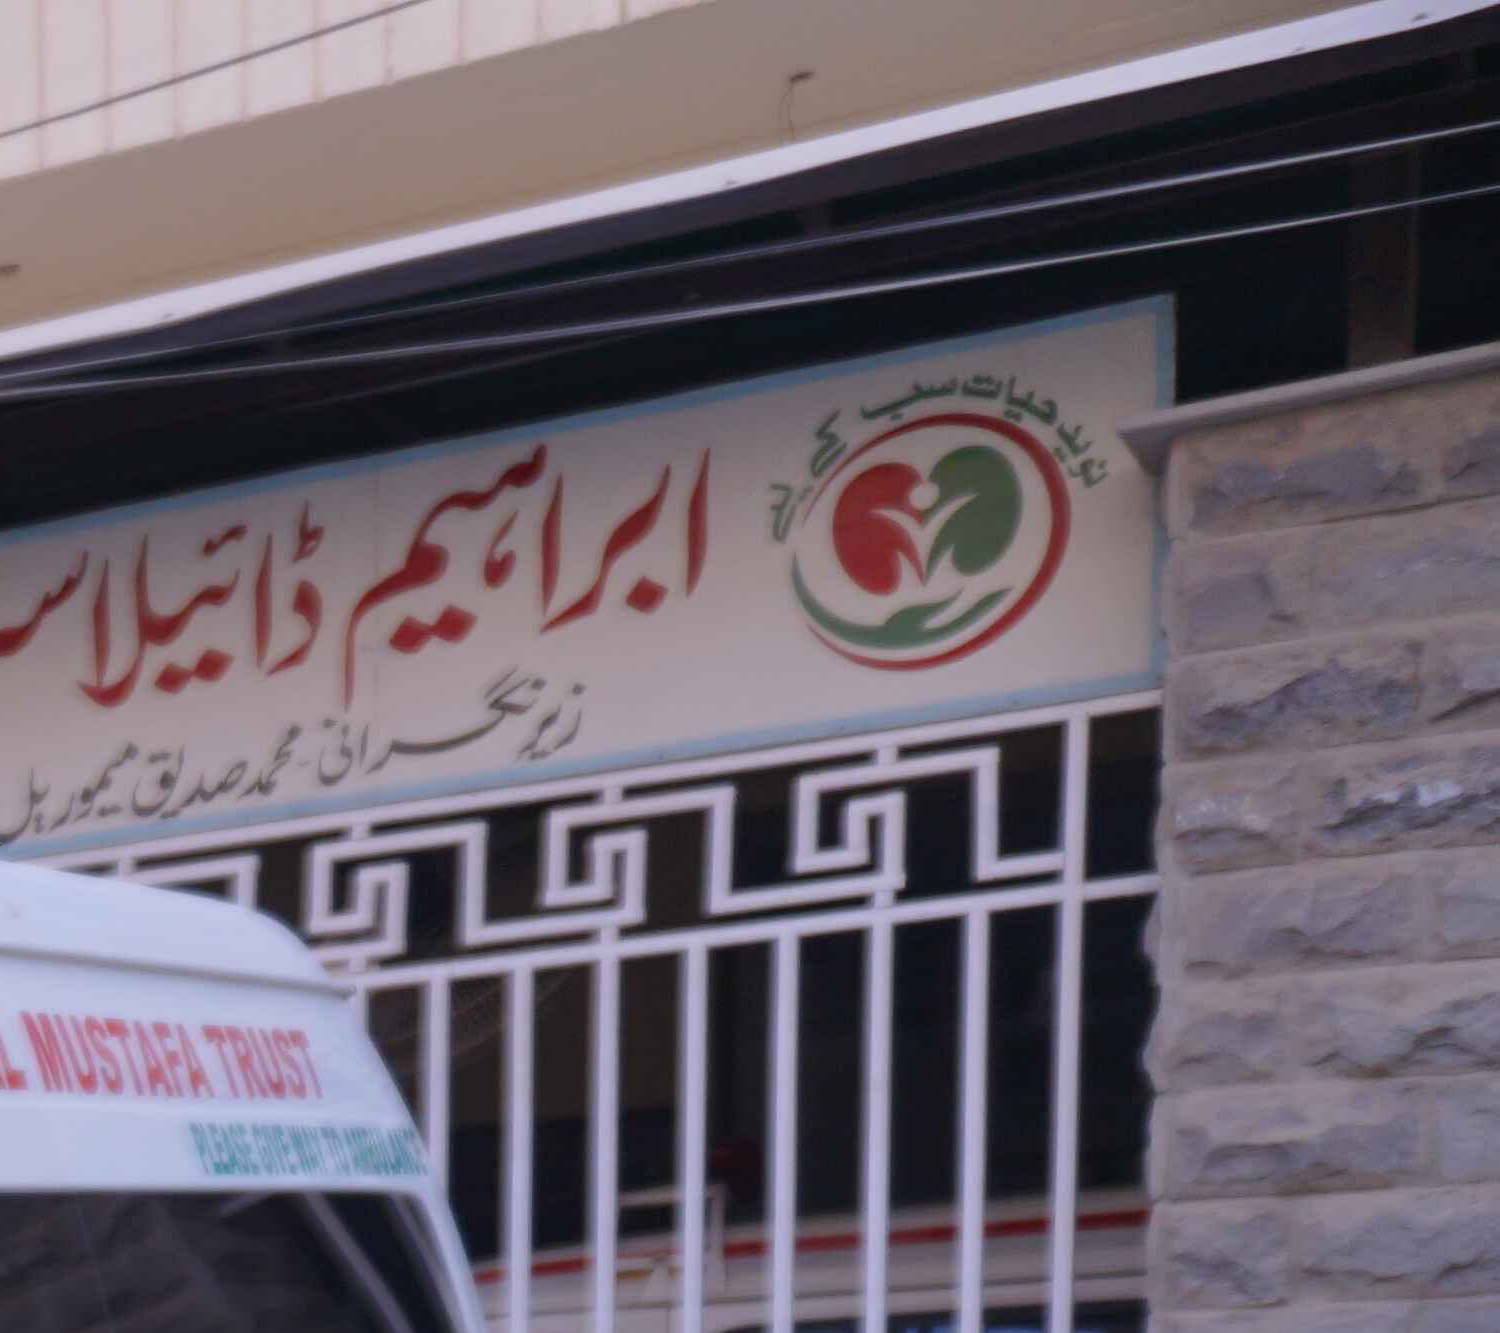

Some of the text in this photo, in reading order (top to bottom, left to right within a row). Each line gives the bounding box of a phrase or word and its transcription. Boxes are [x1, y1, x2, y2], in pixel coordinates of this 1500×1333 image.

[860, 378, 958, 422] سب
[960, 374, 1059, 424] حیات
[342, 444, 711, 708] ابراہیم
[132, 744, 252, 820] صدیق
[252, 724, 303, 800] محمد
[19, 1010, 215, 1098] MUSTAFA
[203, 1023, 323, 1100] TRUST
[189, 1122, 258, 1175] PLEASE
